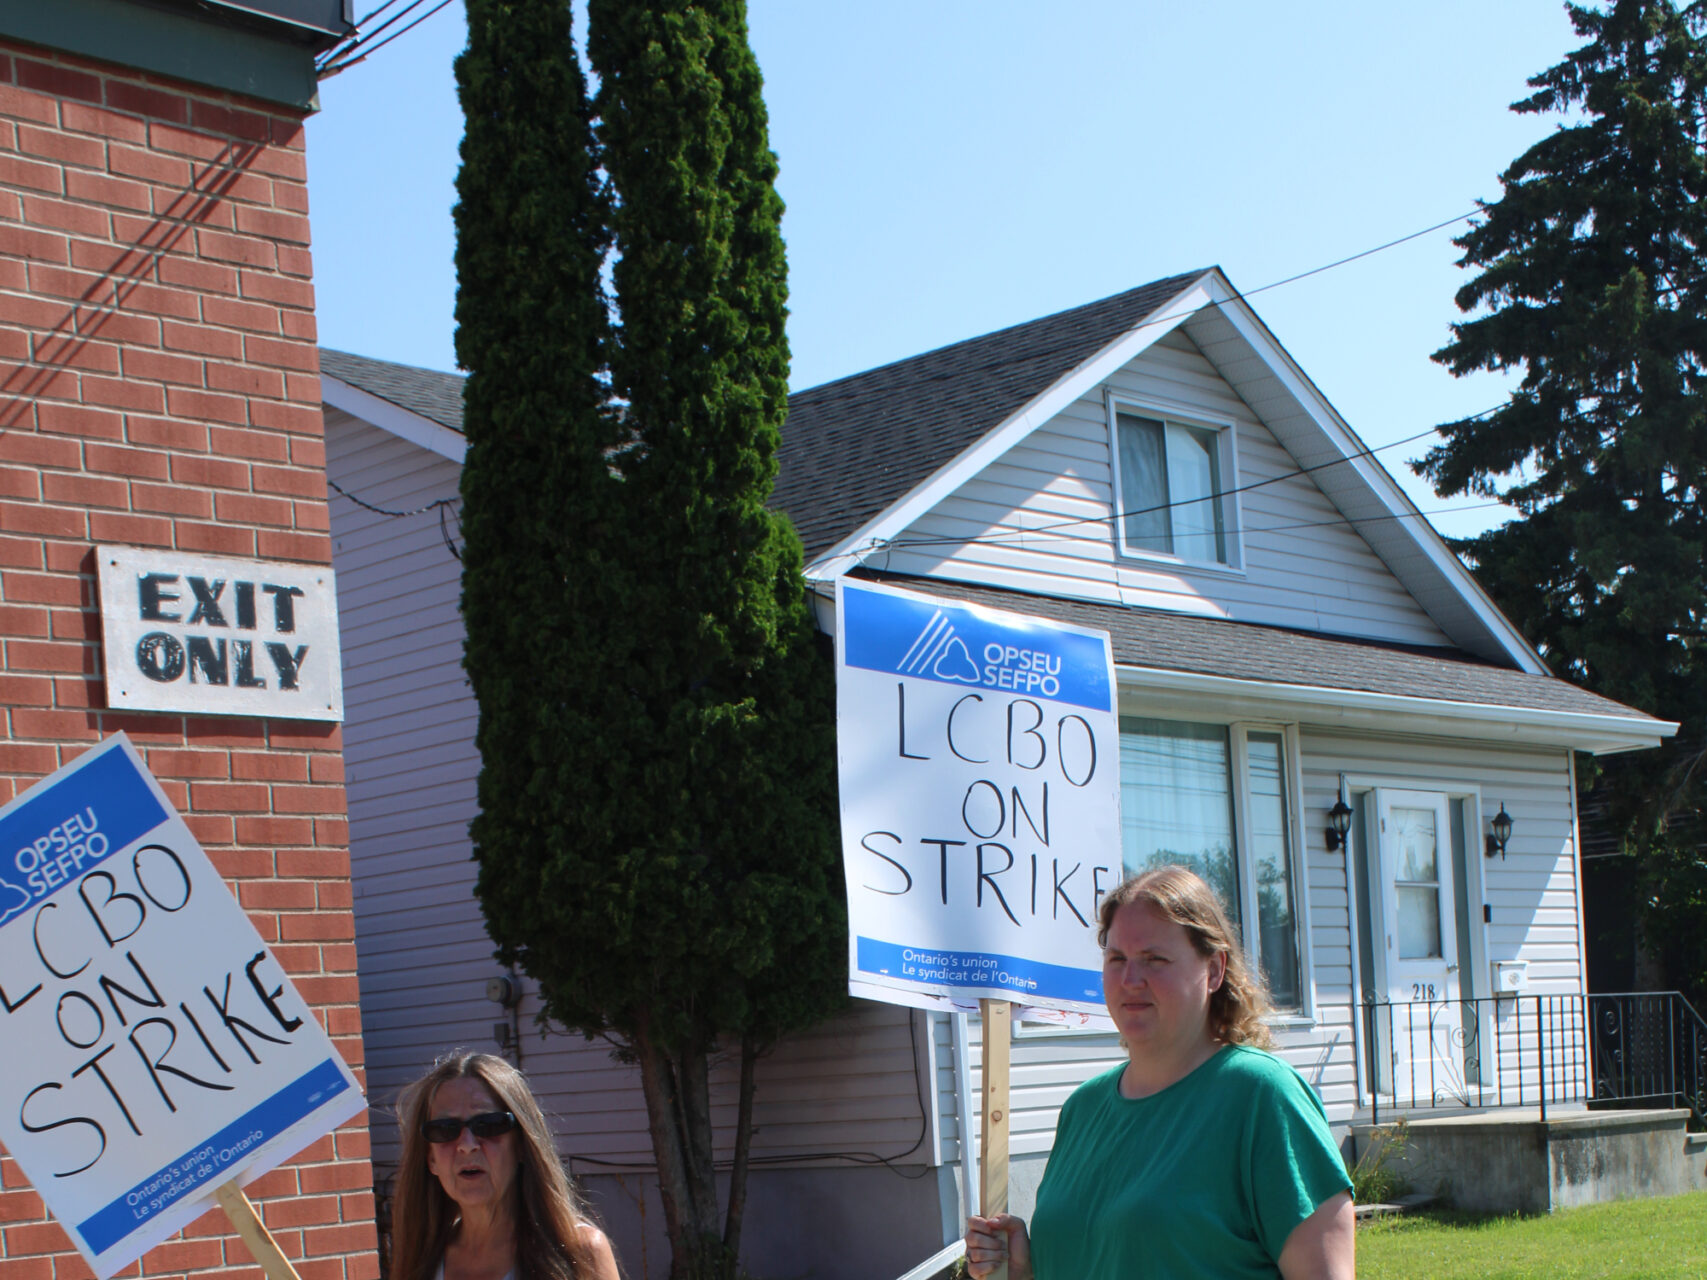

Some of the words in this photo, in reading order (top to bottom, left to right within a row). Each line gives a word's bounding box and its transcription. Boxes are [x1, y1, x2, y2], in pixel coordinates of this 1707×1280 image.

[138, 572, 305, 632] EXIT
[135, 631, 310, 691] ONLY
[983, 665, 1060, 696] SEFPO
[984, 643, 1061, 675] OPSEU
[898, 683, 1096, 786] LCBO
[15, 806, 98, 873] OPSEU
[962, 780, 1049, 847] ON
[27, 832, 109, 897] SEFPO
[902, 963, 915, 975] Le
[918, 968, 967, 982] syndicat
[971, 970, 988, 982] de
[962, 956, 998, 969] union
[1412, 983, 1435, 1000] 218
[56, 951, 167, 1050] ON
[20, 950, 304, 1178] STRIKE
[181, 1145, 215, 1171] union
[133, 1207, 149, 1220] Le
[150, 1174, 197, 1209] syndicat
[197, 1160, 213, 1178] de
